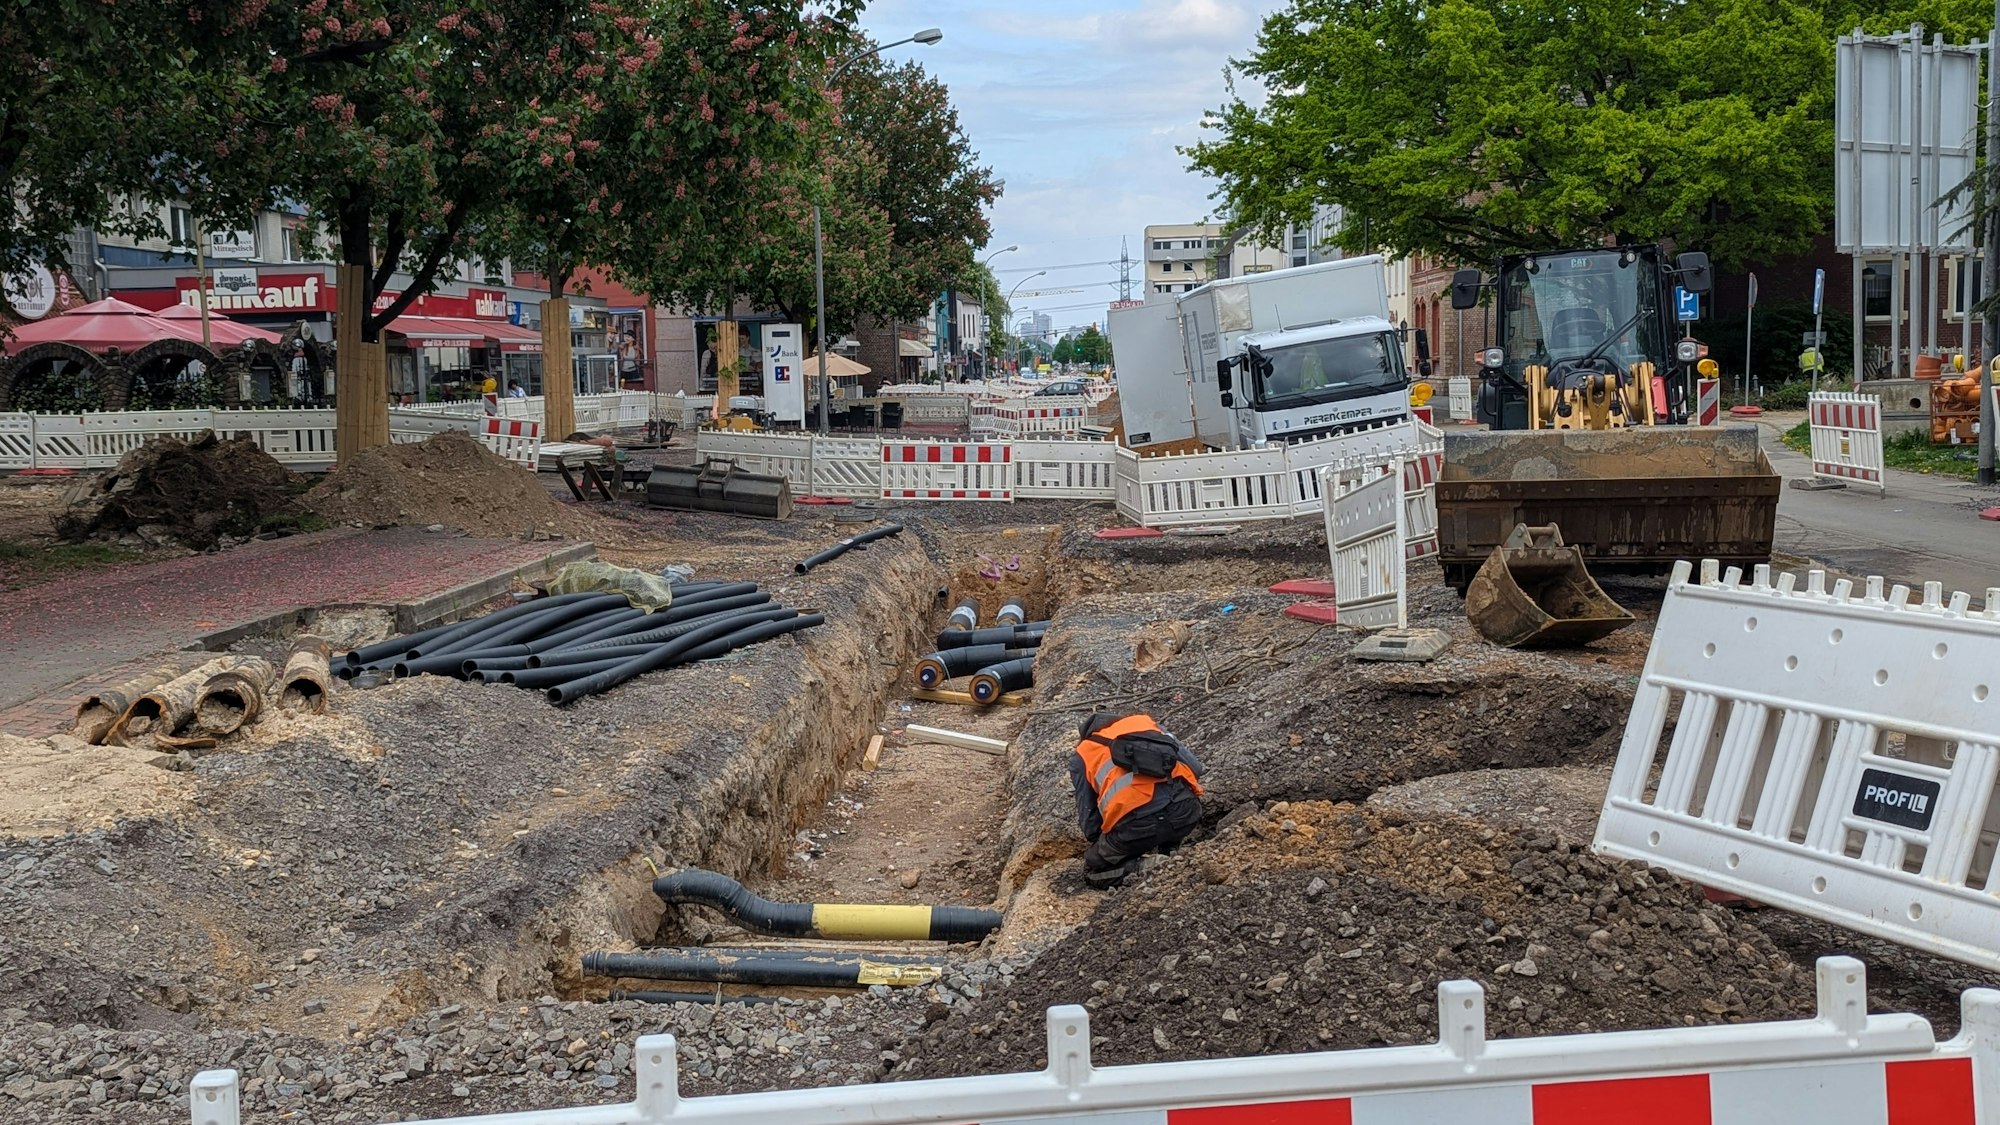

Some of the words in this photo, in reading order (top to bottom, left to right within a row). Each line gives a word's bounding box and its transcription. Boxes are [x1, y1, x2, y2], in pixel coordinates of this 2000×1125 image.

[213, 245, 253, 253] Mittagstisch
[1570, 258, 1587, 268] CAT
[475, 293, 507, 317] nahkauf
[1681, 290, 1694, 309] P
[1863, 784, 1929, 814] PROFIL
